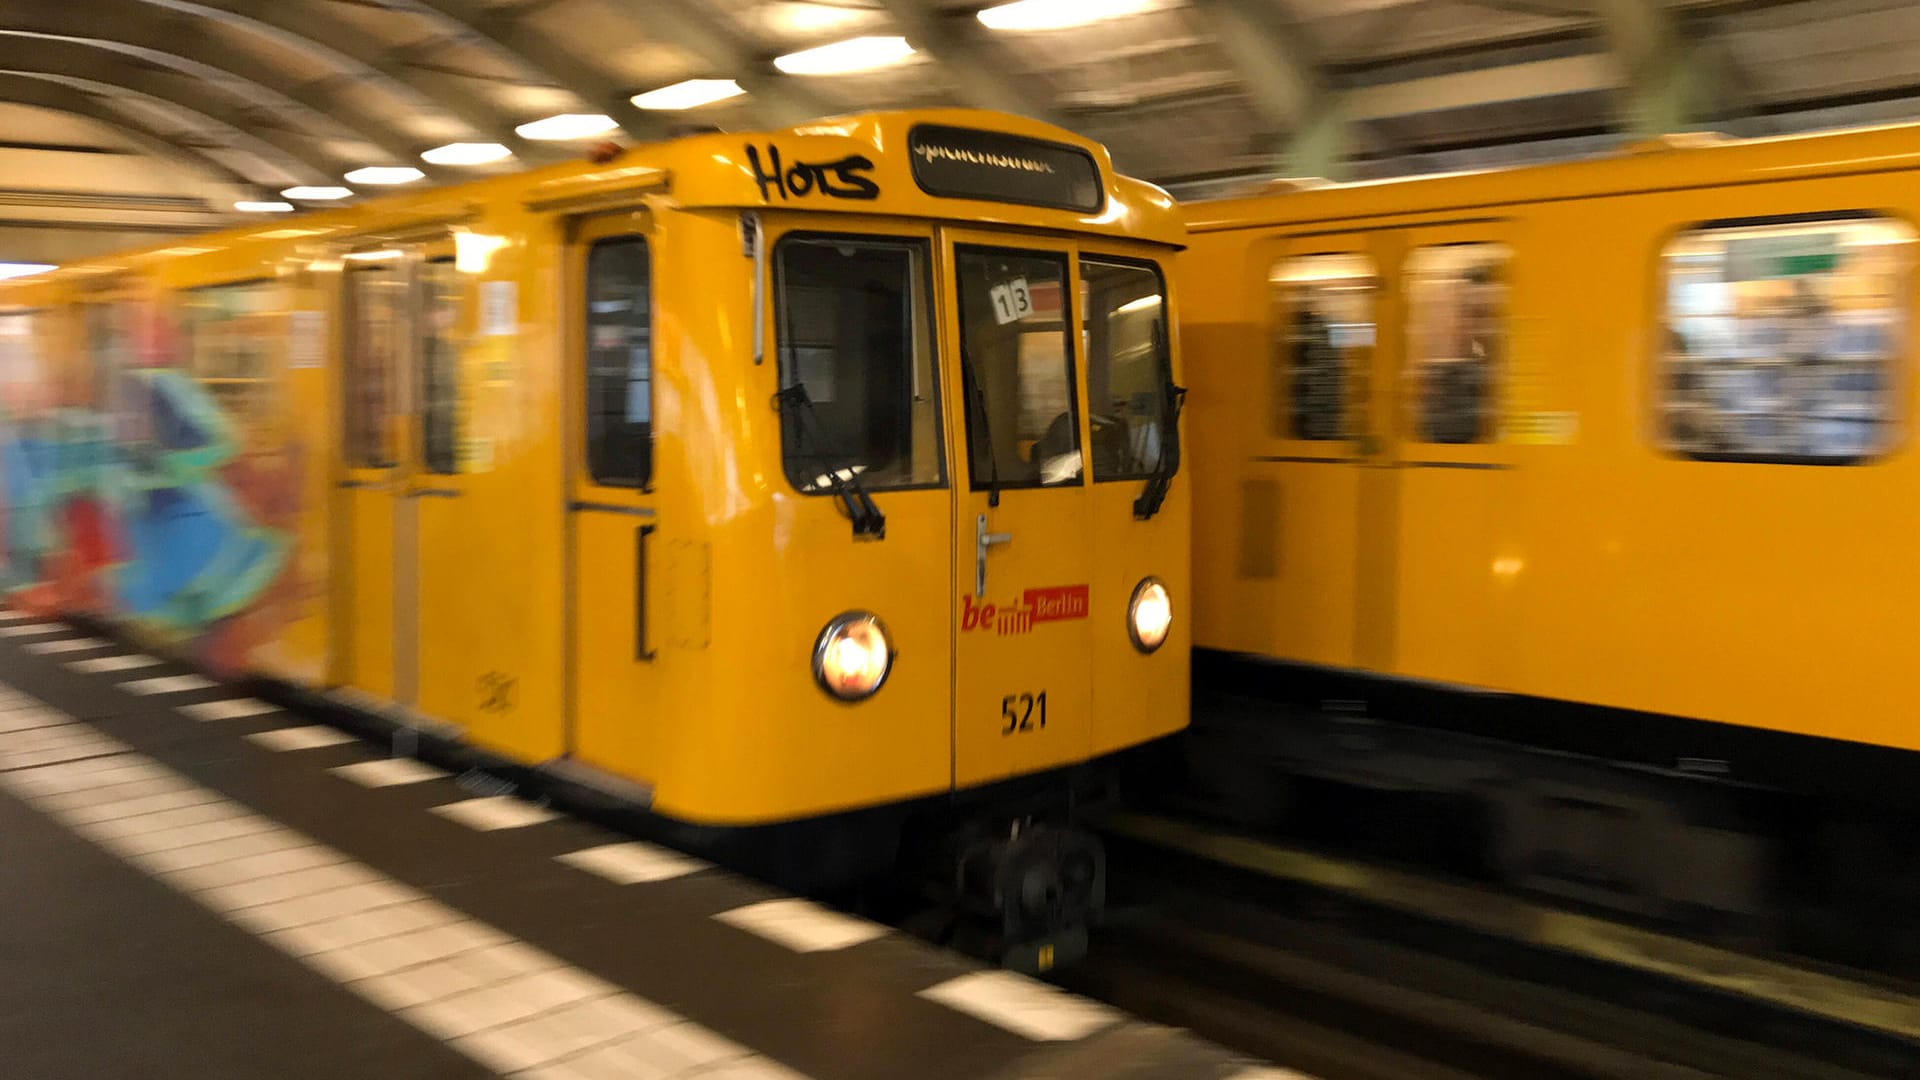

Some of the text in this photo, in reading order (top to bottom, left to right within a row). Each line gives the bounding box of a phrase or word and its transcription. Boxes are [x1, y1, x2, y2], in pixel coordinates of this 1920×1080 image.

[961, 594, 1082, 632] be Berlin
[1001, 690, 1047, 736] 521
